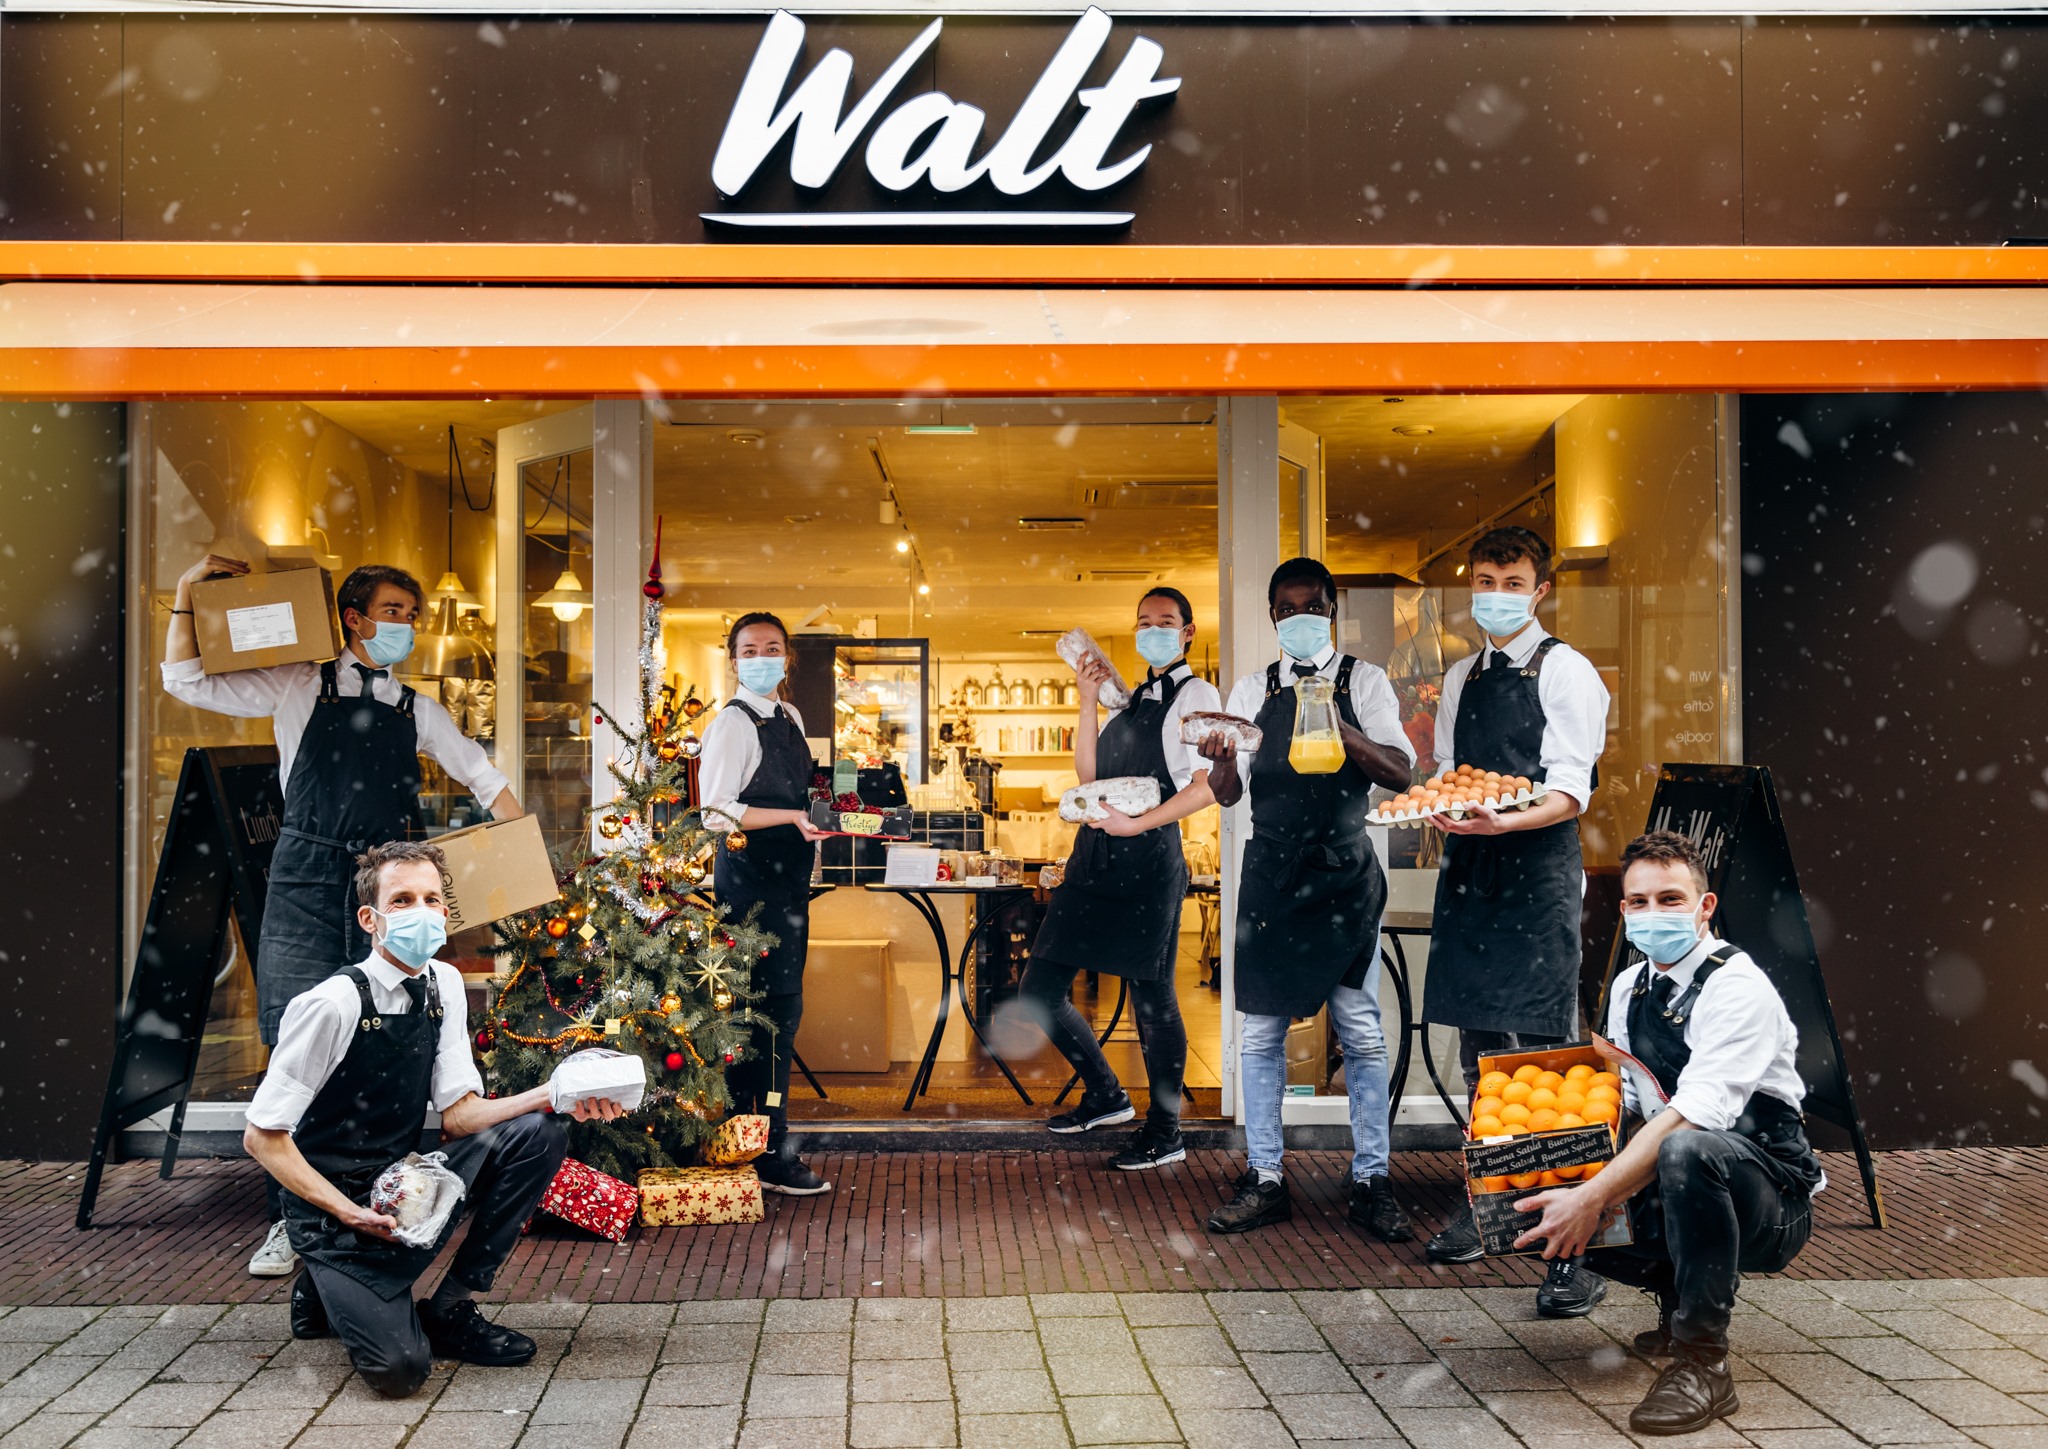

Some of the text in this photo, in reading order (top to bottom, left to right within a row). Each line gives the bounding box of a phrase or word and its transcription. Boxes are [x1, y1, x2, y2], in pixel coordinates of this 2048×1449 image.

[711, 5, 1182, 196] Walt
[841, 814, 882, 834] Prestige
[1472, 1145, 1501, 1159] Buena
[1480, 1166, 1509, 1178] Buena
[1510, 1155, 1536, 1171] Salud
[1541, 1148, 1570, 1163] Buena
[1571, 1138, 1597, 1153] Salud
[1486, 1152, 1515, 1167] Buena
[1516, 1142, 1542, 1155] Salud
[1547, 1135, 1576, 1149] Buena
[1585, 1146, 1612, 1160] Salud
